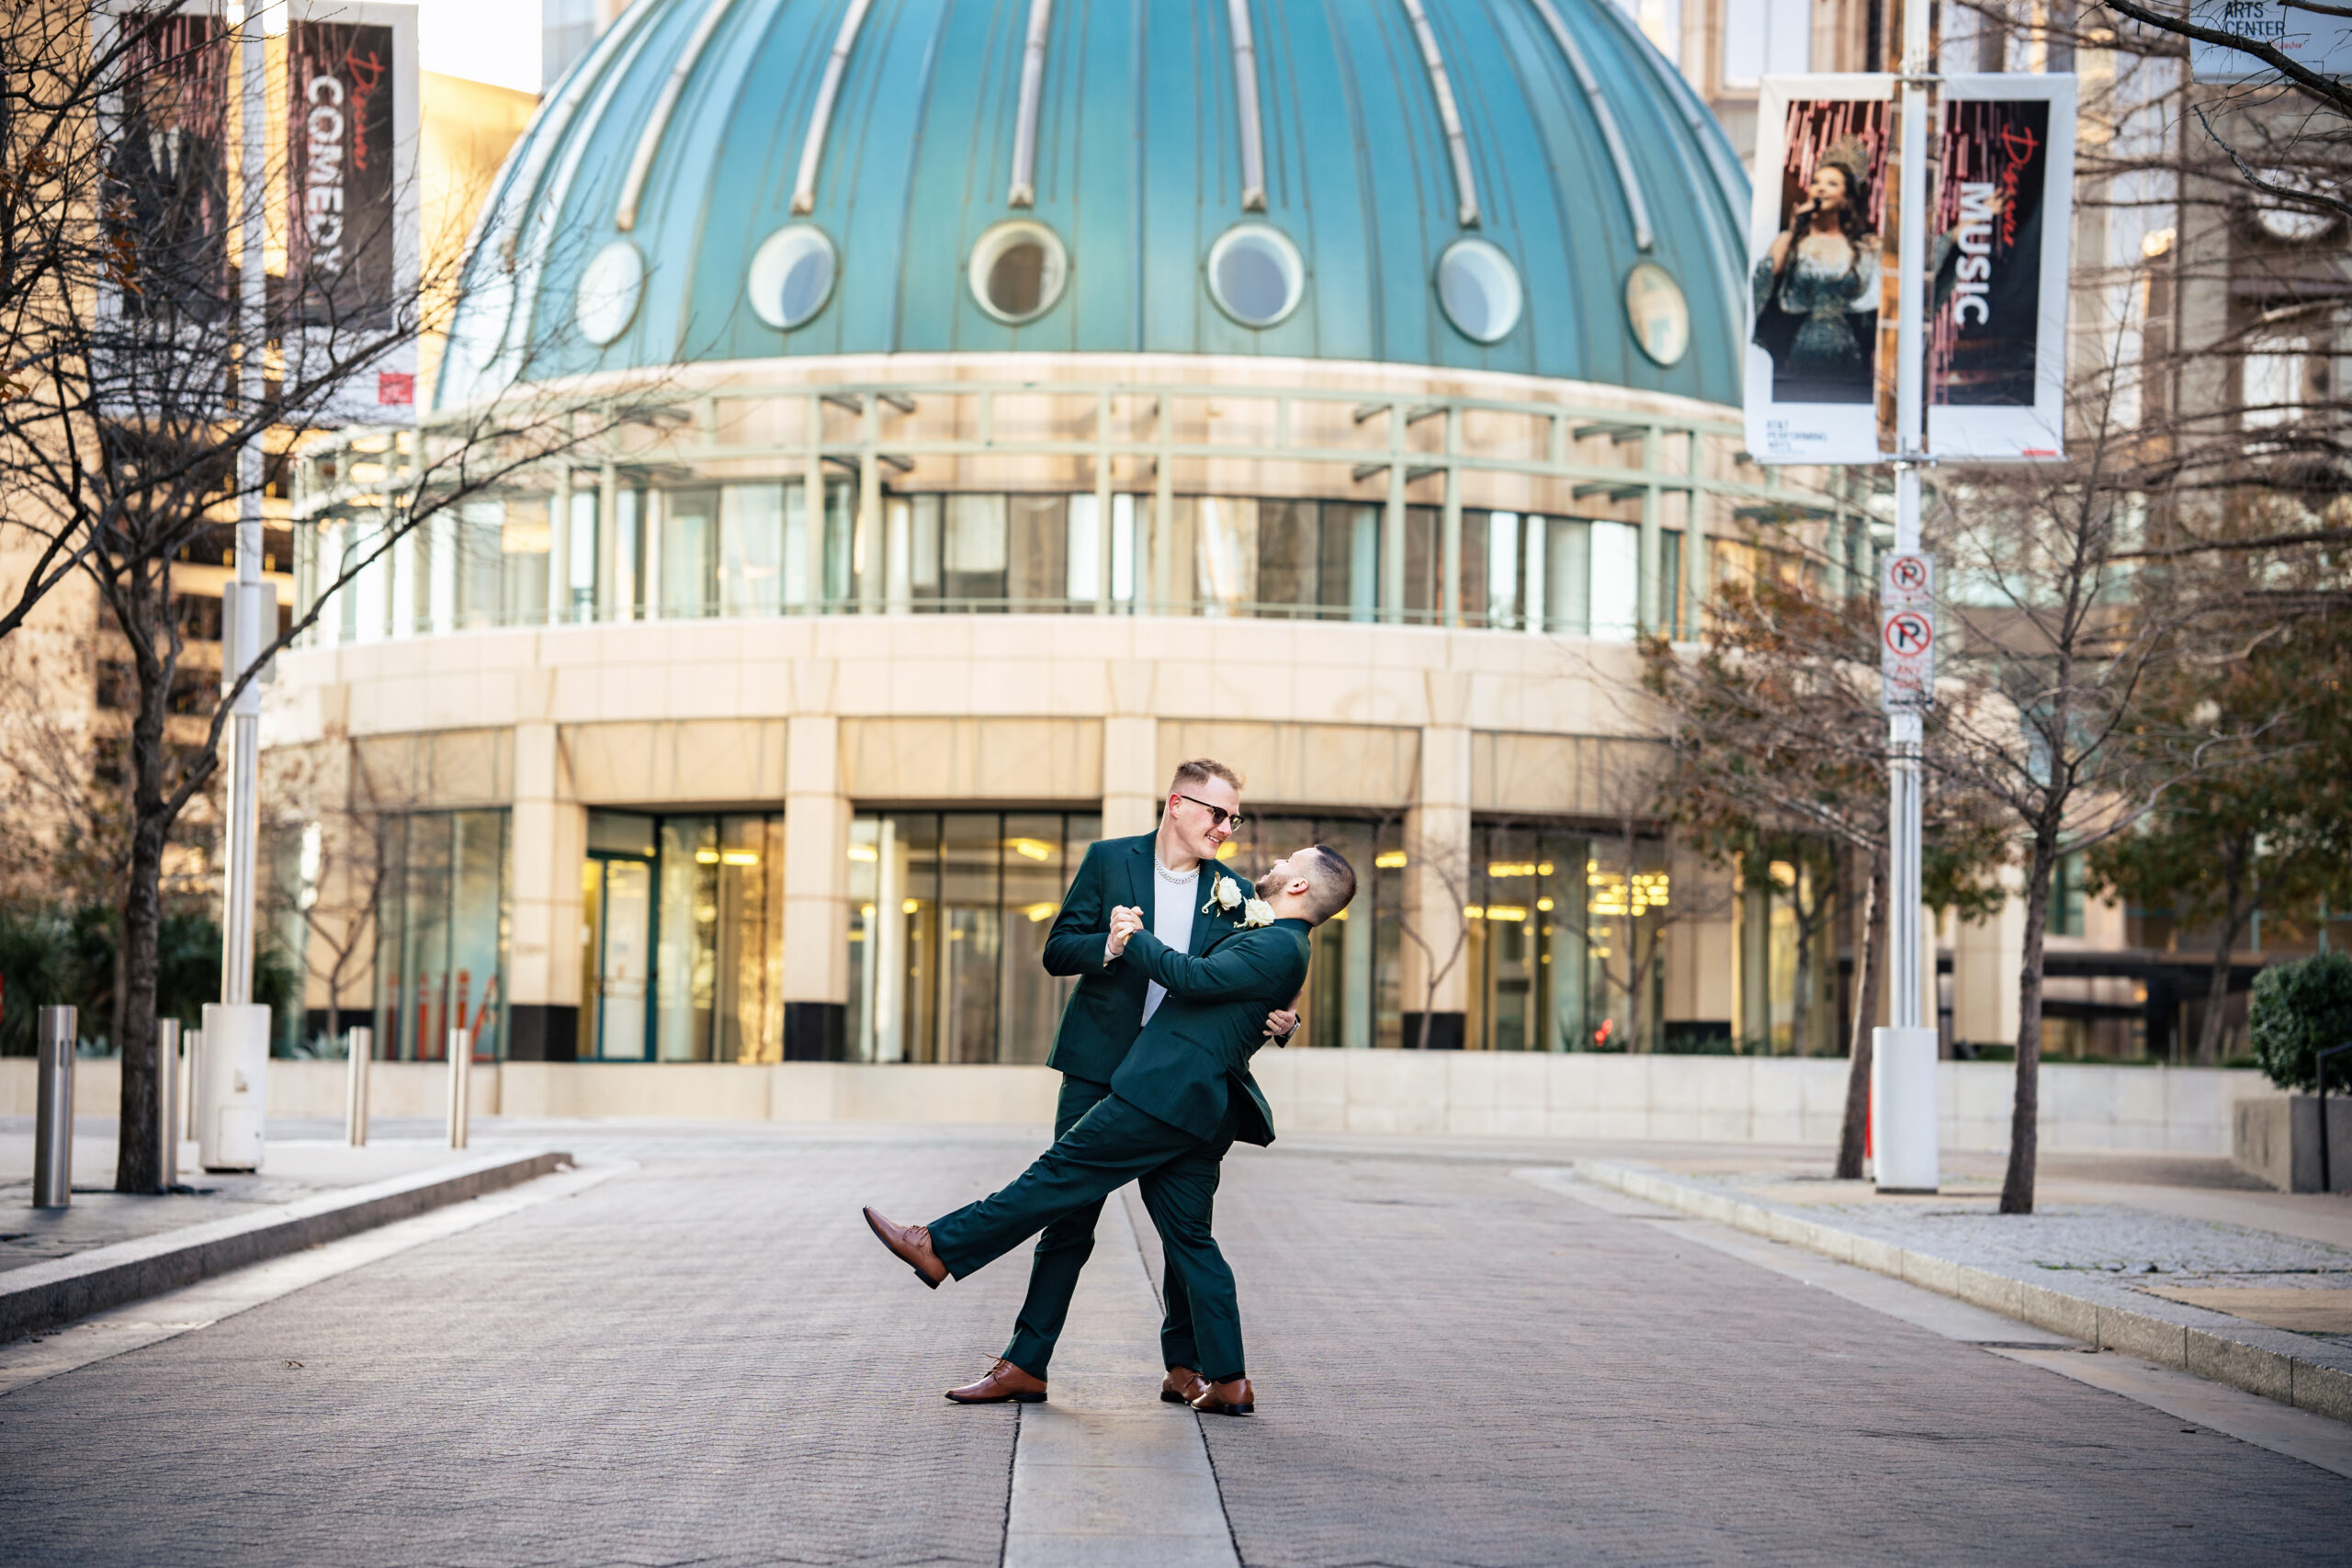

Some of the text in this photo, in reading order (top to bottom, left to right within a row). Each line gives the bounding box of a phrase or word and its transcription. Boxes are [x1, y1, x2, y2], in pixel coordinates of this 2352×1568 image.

[2225, 2, 2264, 18] ARTS
[2225, 20, 2284, 36] CENTER
[346, 48, 385, 171] Discover
[308, 74, 344, 272] COMEDY
[2001, 123, 2039, 247] Discover
[1953, 182, 1995, 325] MUSIC
